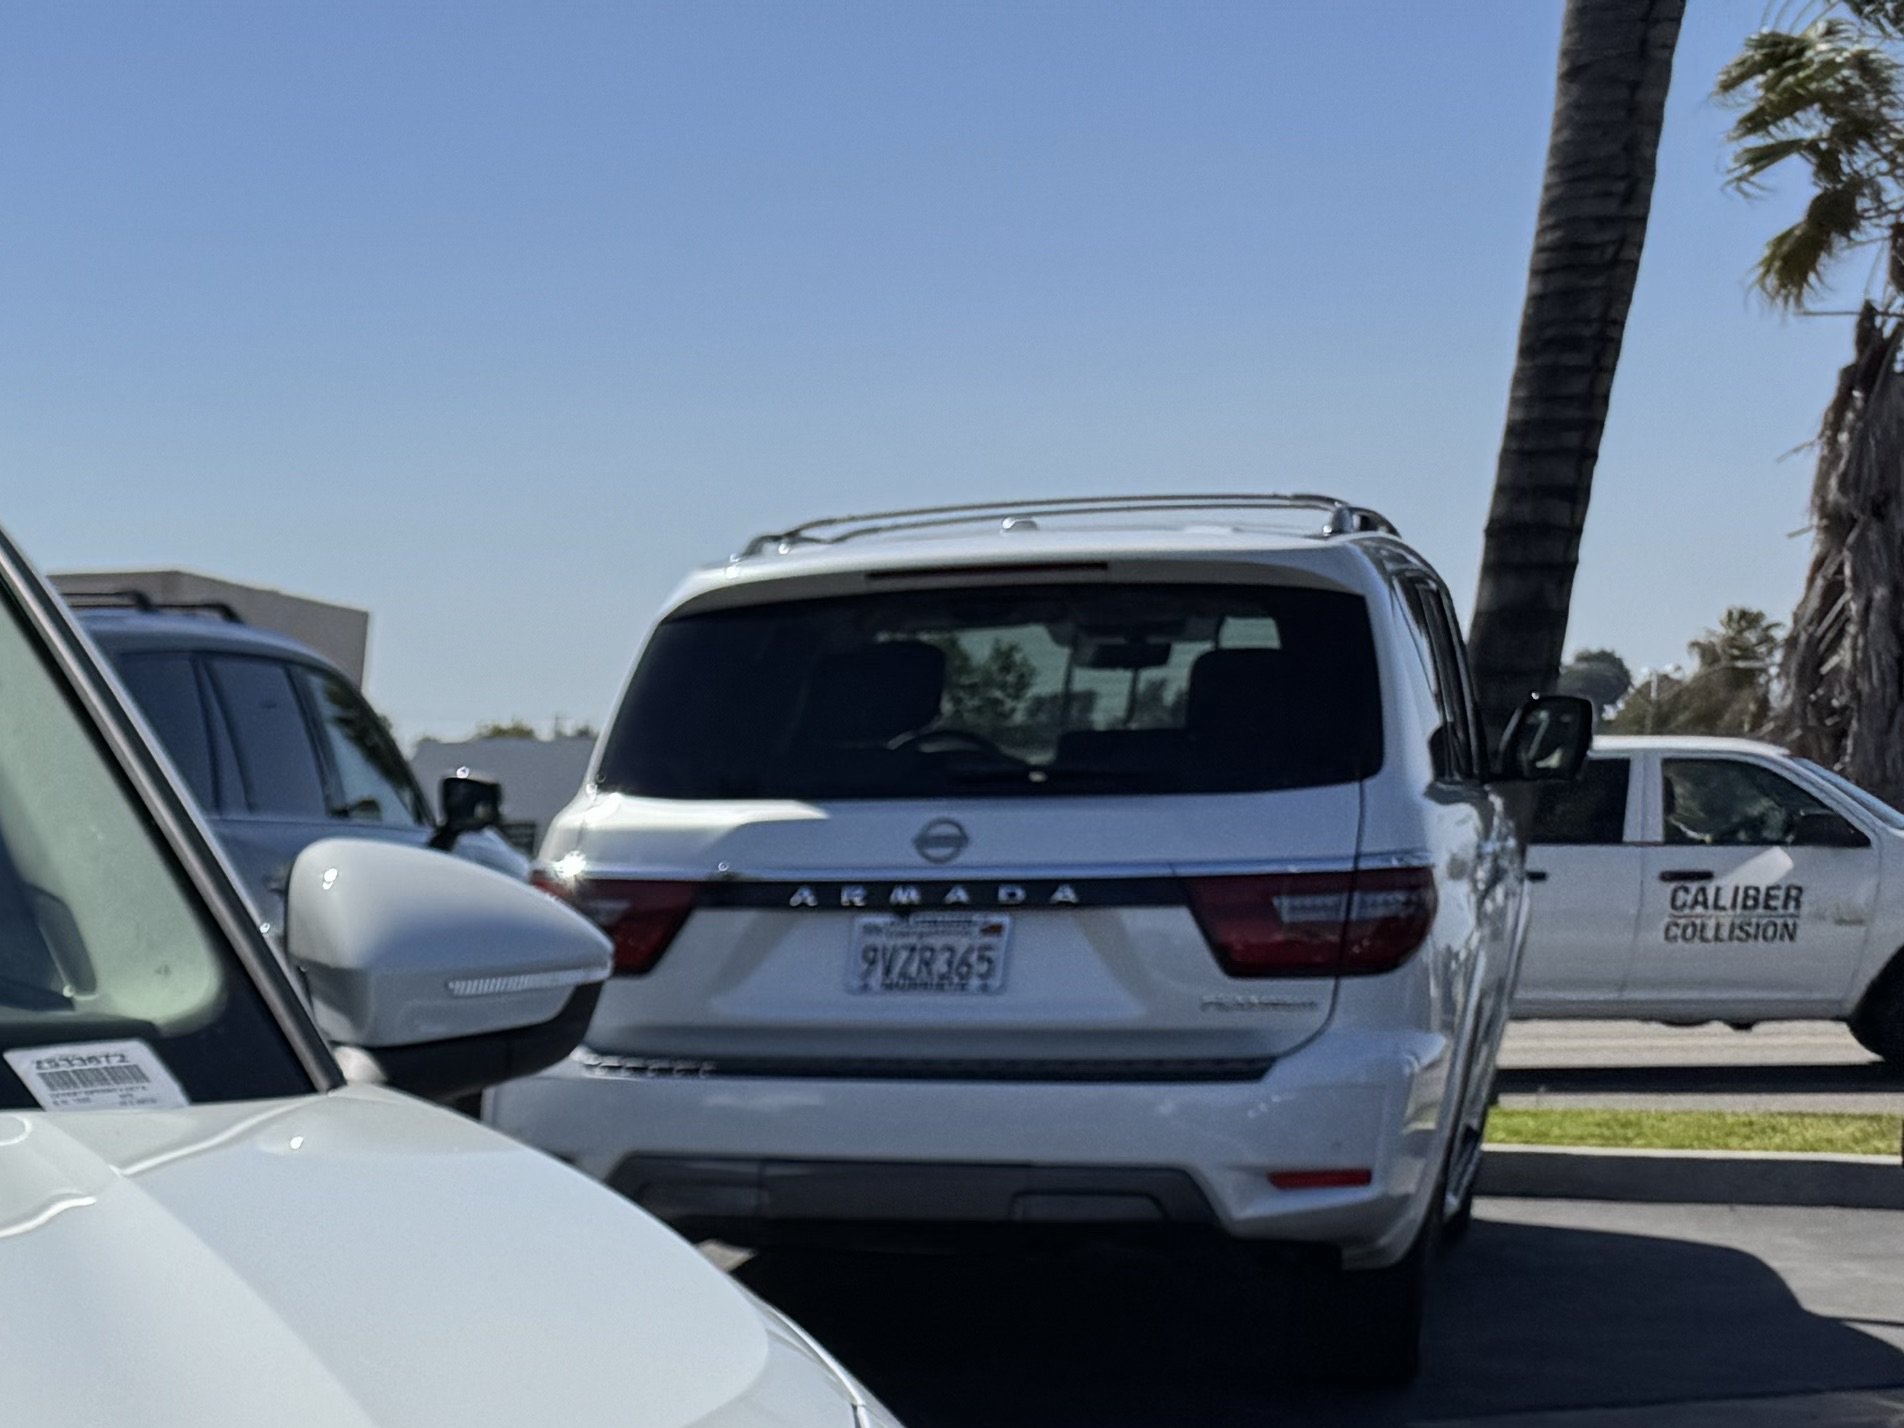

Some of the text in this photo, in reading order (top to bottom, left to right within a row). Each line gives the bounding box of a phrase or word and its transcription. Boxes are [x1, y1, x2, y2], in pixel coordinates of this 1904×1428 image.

[789, 883, 1079, 907] ARMADA
[1669, 884, 1804, 912] CALIBER
[1663, 919, 1798, 944] COLLISION
